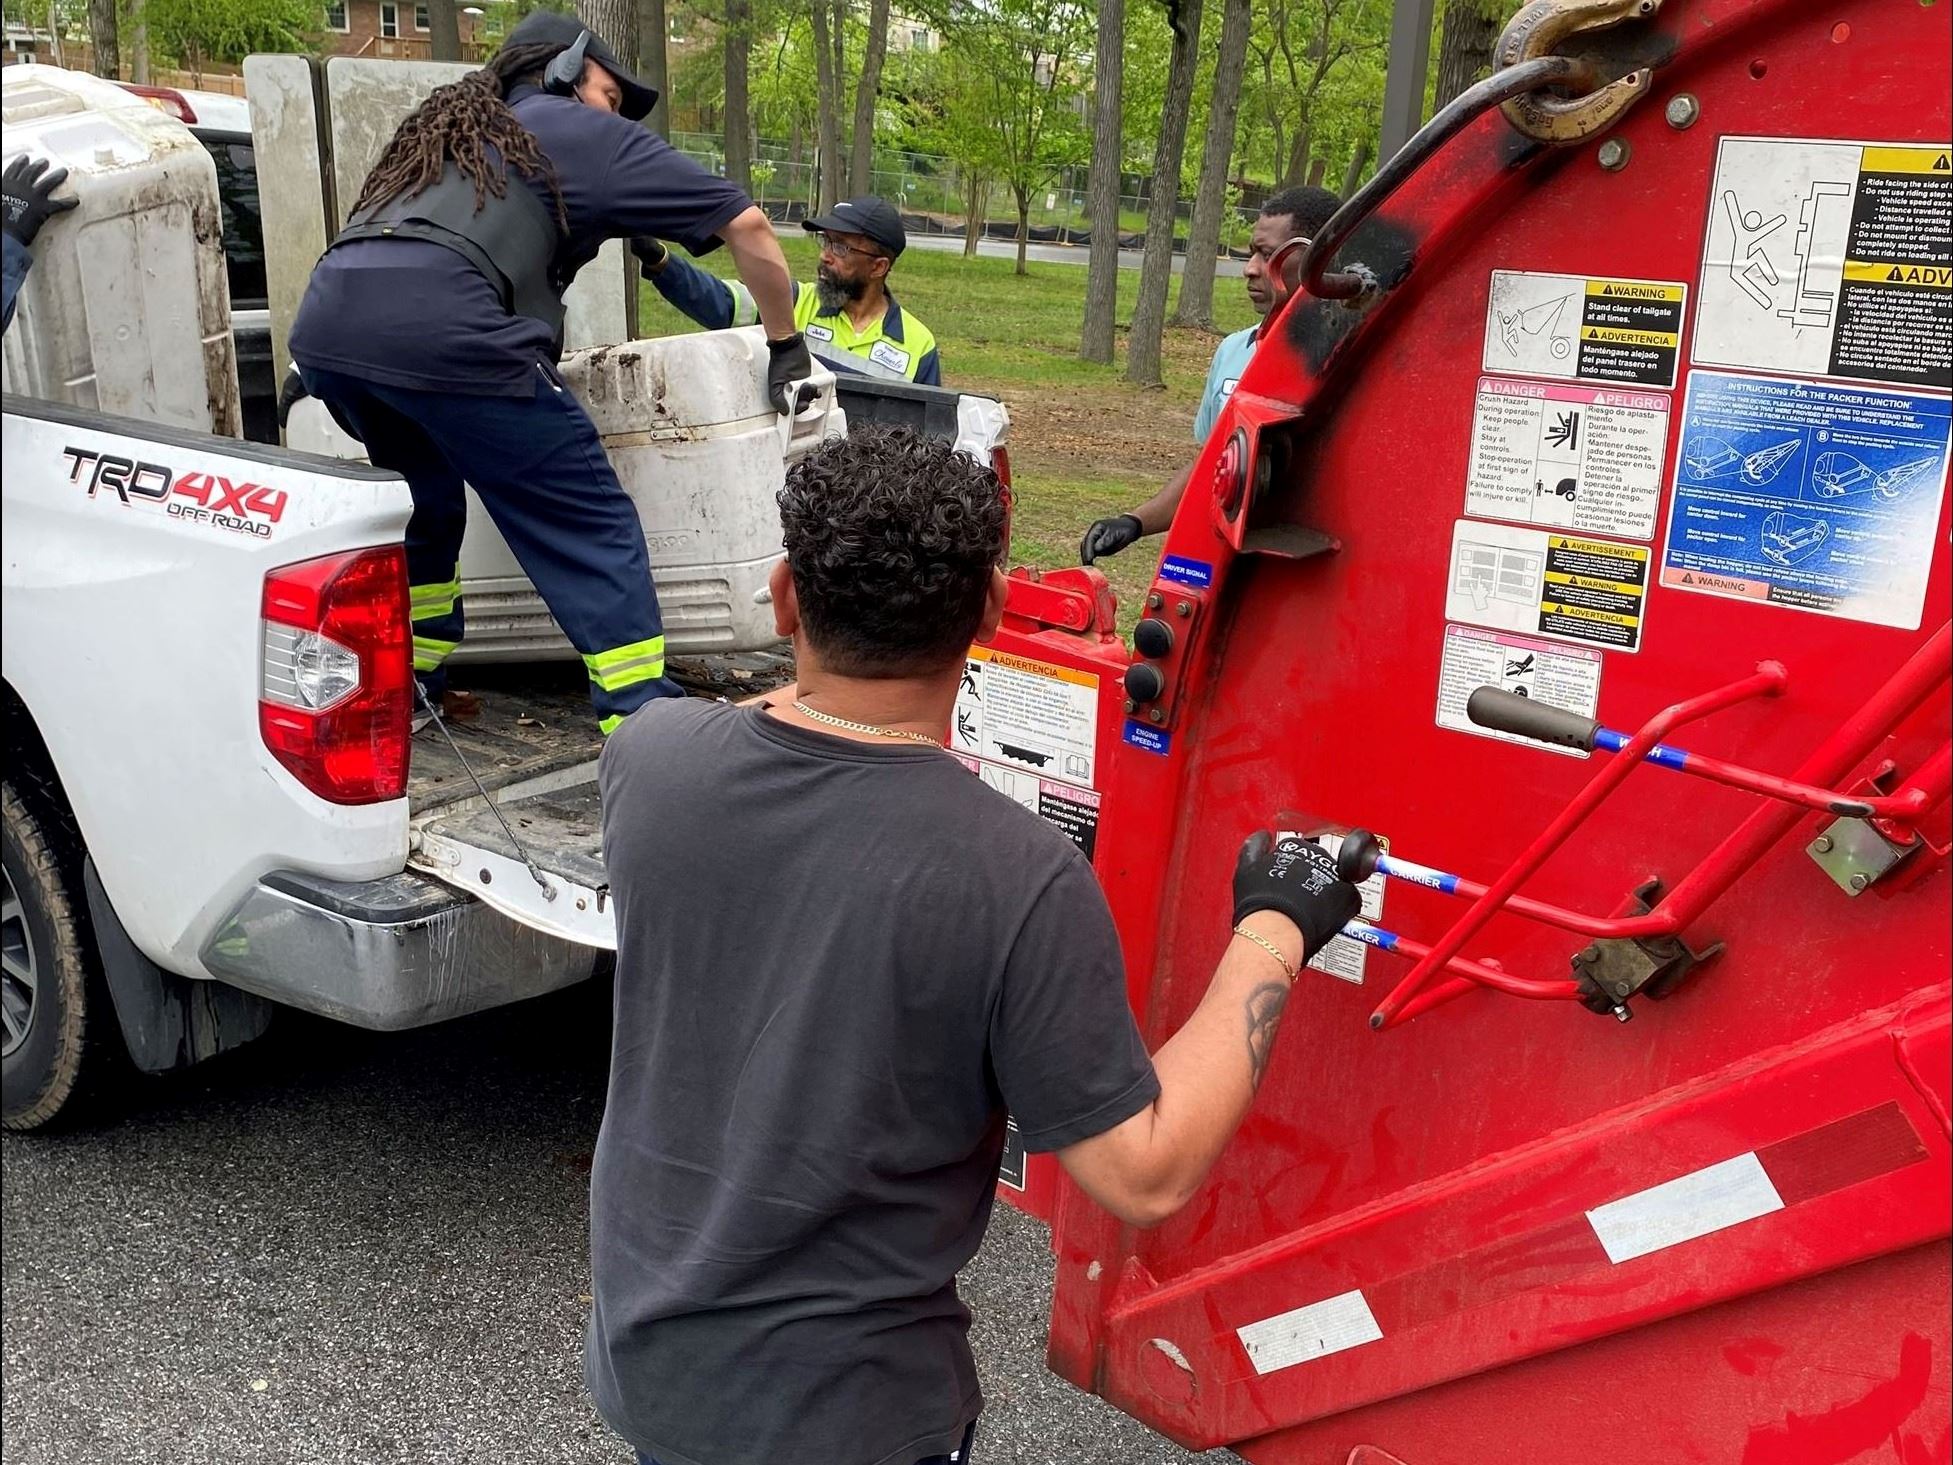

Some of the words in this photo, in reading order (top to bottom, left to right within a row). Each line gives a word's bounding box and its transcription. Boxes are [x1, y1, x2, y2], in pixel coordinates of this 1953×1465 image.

[1885, 180, 1908, 188] facing
[1910, 180, 1921, 188] the
[1906, 189, 1928, 198] riding
[1929, 190, 1946, 198] step
[1881, 197, 1908, 205] Vehicle
[1909, 198, 1932, 207] speed
[1880, 206, 1911, 214] Distance
[1913, 207, 1945, 215] travelled
[1915, 216, 1950, 226] operating
[1885, 223, 1914, 232] attempt
[1924, 225, 1949, 233] collect
[1857, 240, 1896, 249] completely
[1898, 242, 1930, 250] stopped.
[1868, 248, 1879, 256] not
[1881, 249, 1895, 257] ride
[1908, 250, 1936, 260] loading
[1937, 252, 1949, 260] sill
[1614, 288, 1665, 299] WARNING
[1589, 302, 1611, 312] Stand
[1613, 305, 1631, 314] clear
[1633, 305, 1641, 314] of
[1643, 306, 1672, 316] tailgate
[1608, 315, 1630, 323] times.
[1601, 333, 1669, 345] ADVERTENCIA
[1584, 345, 1629, 358] Manténgase
[1631, 349, 1659, 359] alejado
[1582, 356, 1594, 364] del
[1596, 357, 1616, 367] panel
[1619, 360, 1645, 368] trasero
[1582, 366, 1598, 374] todo
[1600, 368, 1638, 378] momento.
[1493, 384, 1545, 397] DANGER
[1728, 383, 1788, 396] INSTRUCTIONS
[1790, 388, 1806, 398] FOR
[1810, 391, 1826, 400] THE
[1828, 393, 1863, 404] PACKER
[1479, 394, 1501, 403] Crush
[1502, 397, 1528, 406] Hazard
[1605, 395, 1664, 409] PELIGRO
[1478, 404, 1502, 414] During
[1588, 406, 1614, 415] Riesgo
[1773, 400, 1795, 408] PLEASE
[1813, 403, 1825, 411] AND
[1862, 410, 1901, 420] UNDERSTAND
[1484, 414, 1502, 424] Keep
[1503, 417, 1528, 426] people
[1587, 415, 1613, 423] miento
[1792, 409, 1821, 418] PROVIDED
[1879, 418, 1924, 429] REPLACEMENT
[1481, 434, 1498, 443] Stay
[1587, 448, 1604, 456] jado
[1486, 464, 1500, 472] first
[1503, 466, 1518, 475] sign
[1520, 466, 1528, 474] of
[64, 446, 174, 506] TRD
[172, 471, 289, 523] 4X4
[1470, 481, 1494, 490] Failure
[1506, 486, 1532, 496] comply
[1576, 504, 1627, 517] cumplimiento
[1629, 511, 1652, 520] puede
[167, 503, 209, 524] OFF
[212, 512, 272, 540] ROAD
[1576, 513, 1613, 522] ocasionar
[1614, 516, 1645, 526] lesiones
[1571, 542, 1637, 558] AVERTISSEMENT
[1163, 563, 1185, 574] DRIVER
[1186, 568, 1207, 579] SIGNAL
[1580, 579, 1617, 591] WARNING
[1698, 576, 1745, 591] WARNING
[1569, 608, 1624, 623] ADVERTENCIA
[999, 657, 1058, 678] ADVERTENCIA
[1136, 728, 1159, 741] ENGINE
[1131, 735, 1162, 750] SPEED-UP
[1054, 786, 1099, 805] PELIGRO
[1051, 809, 1086, 824] mecanismo
[1069, 824, 1078, 832] del
[1344, 926, 1379, 945] ACKER
